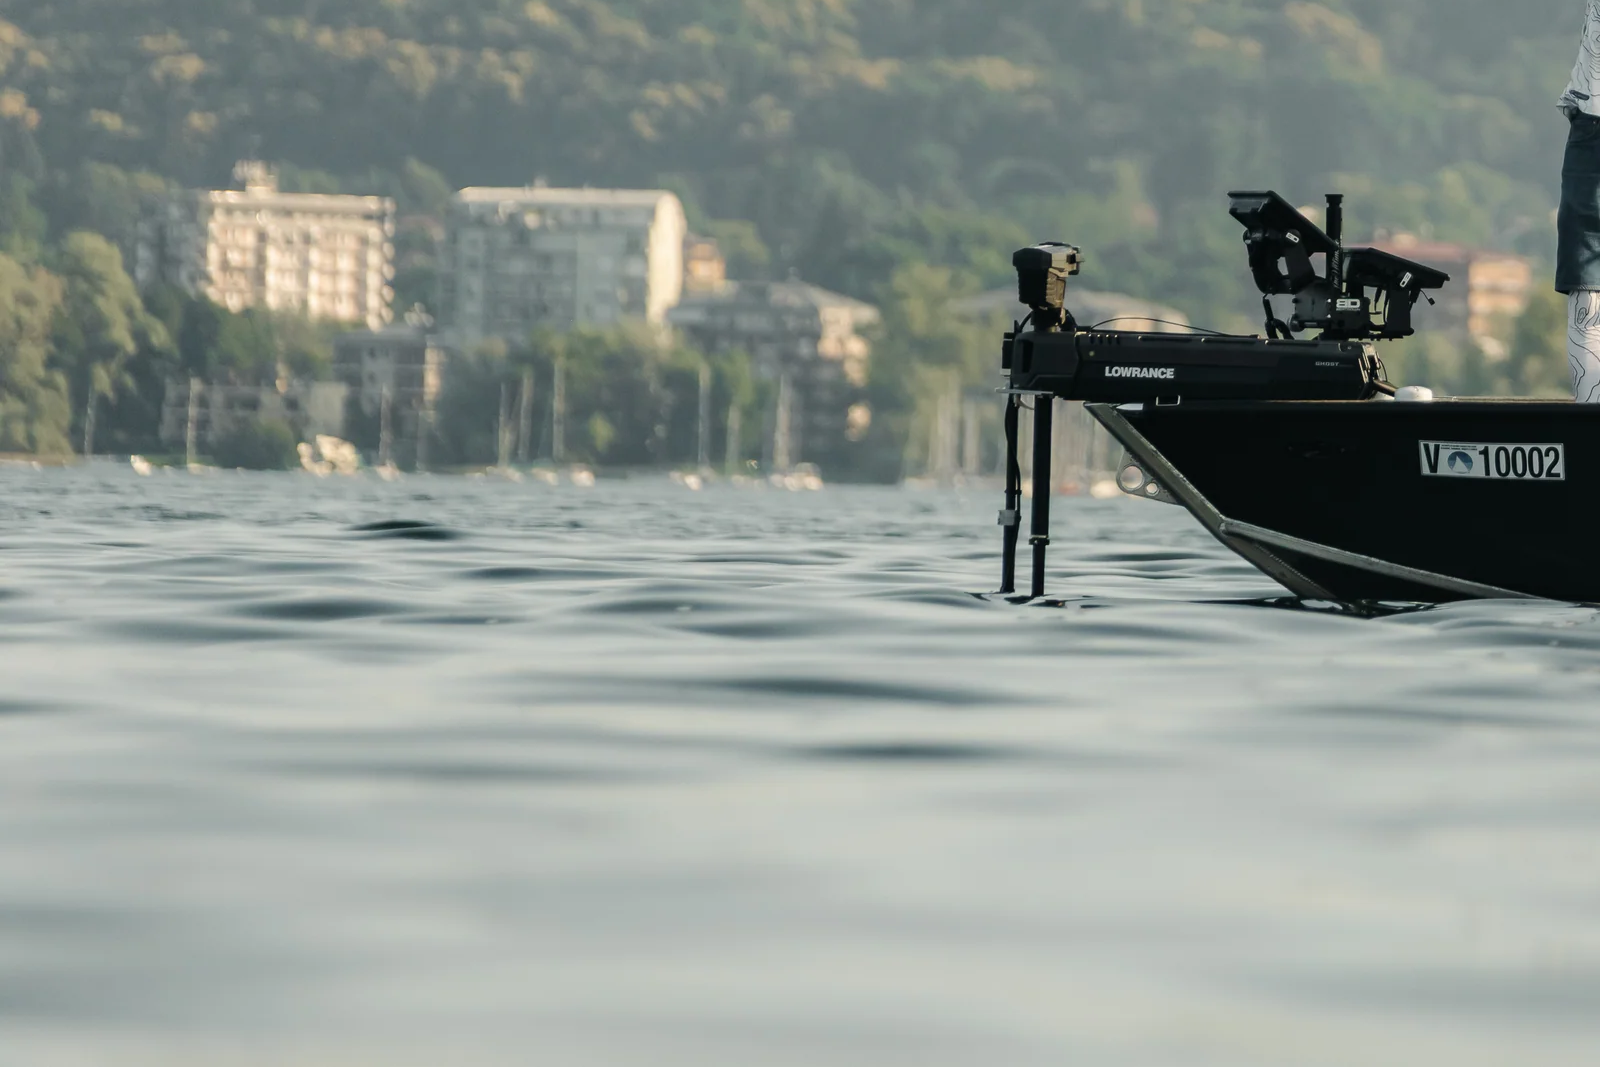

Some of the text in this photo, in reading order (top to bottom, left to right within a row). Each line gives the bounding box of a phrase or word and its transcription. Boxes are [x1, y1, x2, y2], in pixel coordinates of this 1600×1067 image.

[1104, 365, 1175, 379] LOWRANCE
[1422, 443, 1561, 478] V 10002
